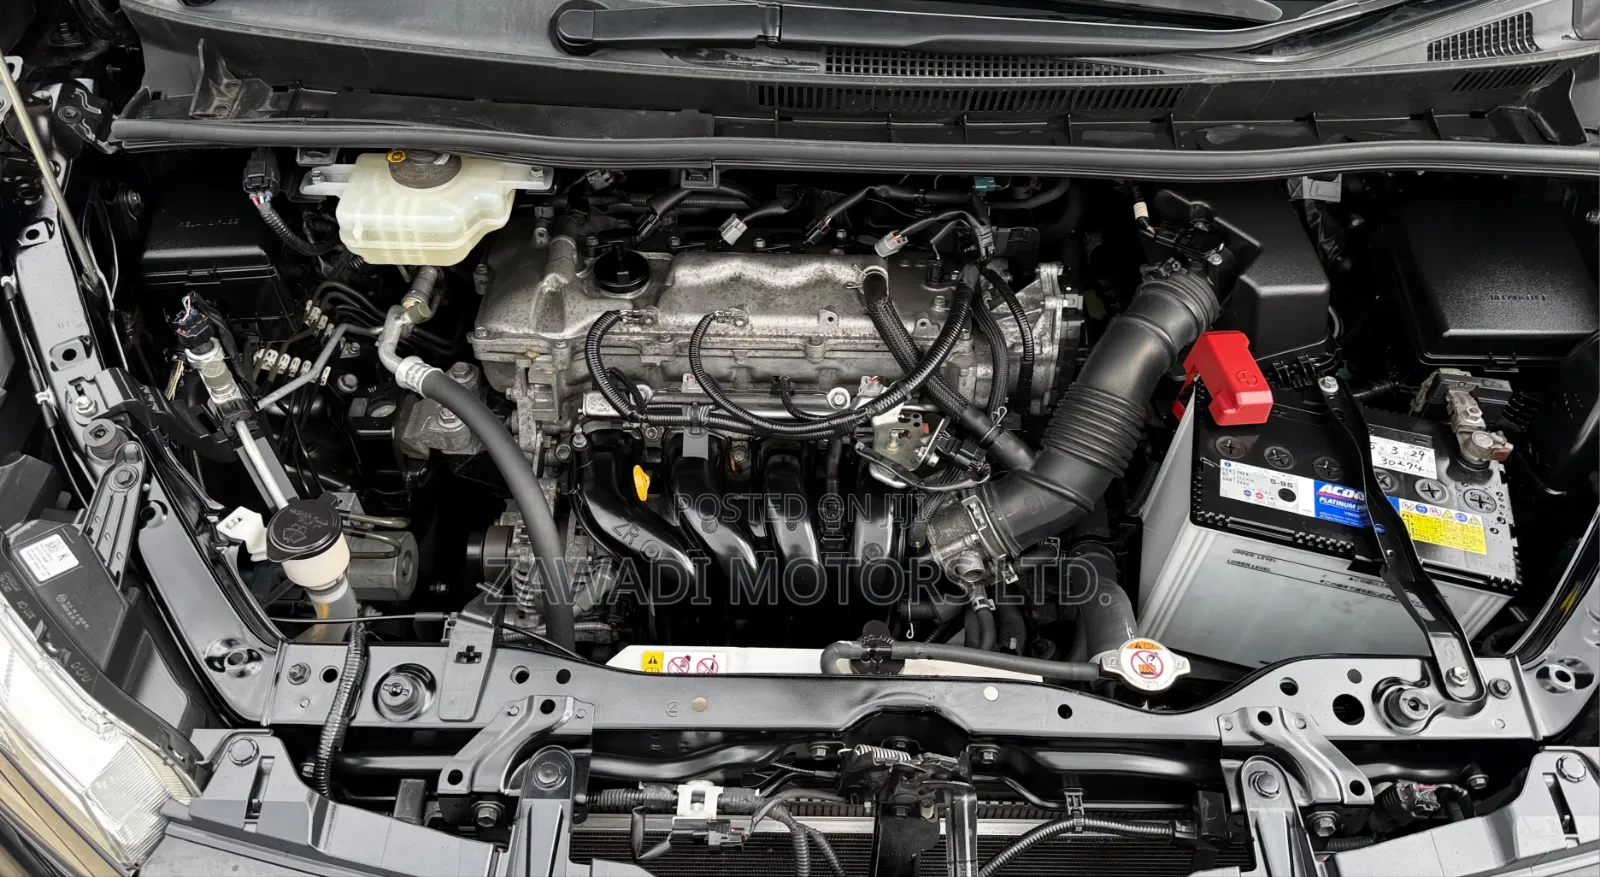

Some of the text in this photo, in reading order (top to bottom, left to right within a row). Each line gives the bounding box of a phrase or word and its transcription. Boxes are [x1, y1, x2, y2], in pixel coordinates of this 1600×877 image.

[1391, 446, 1399, 455] 3
[1410, 450, 1425, 461] 29
[1319, 496, 1357, 511] PLATINUM
[612, 523, 640, 545] ZR
[1232, 549, 1277, 564] UPPER LEVEL
[1226, 558, 1271, 573] LOWER LEVEL
